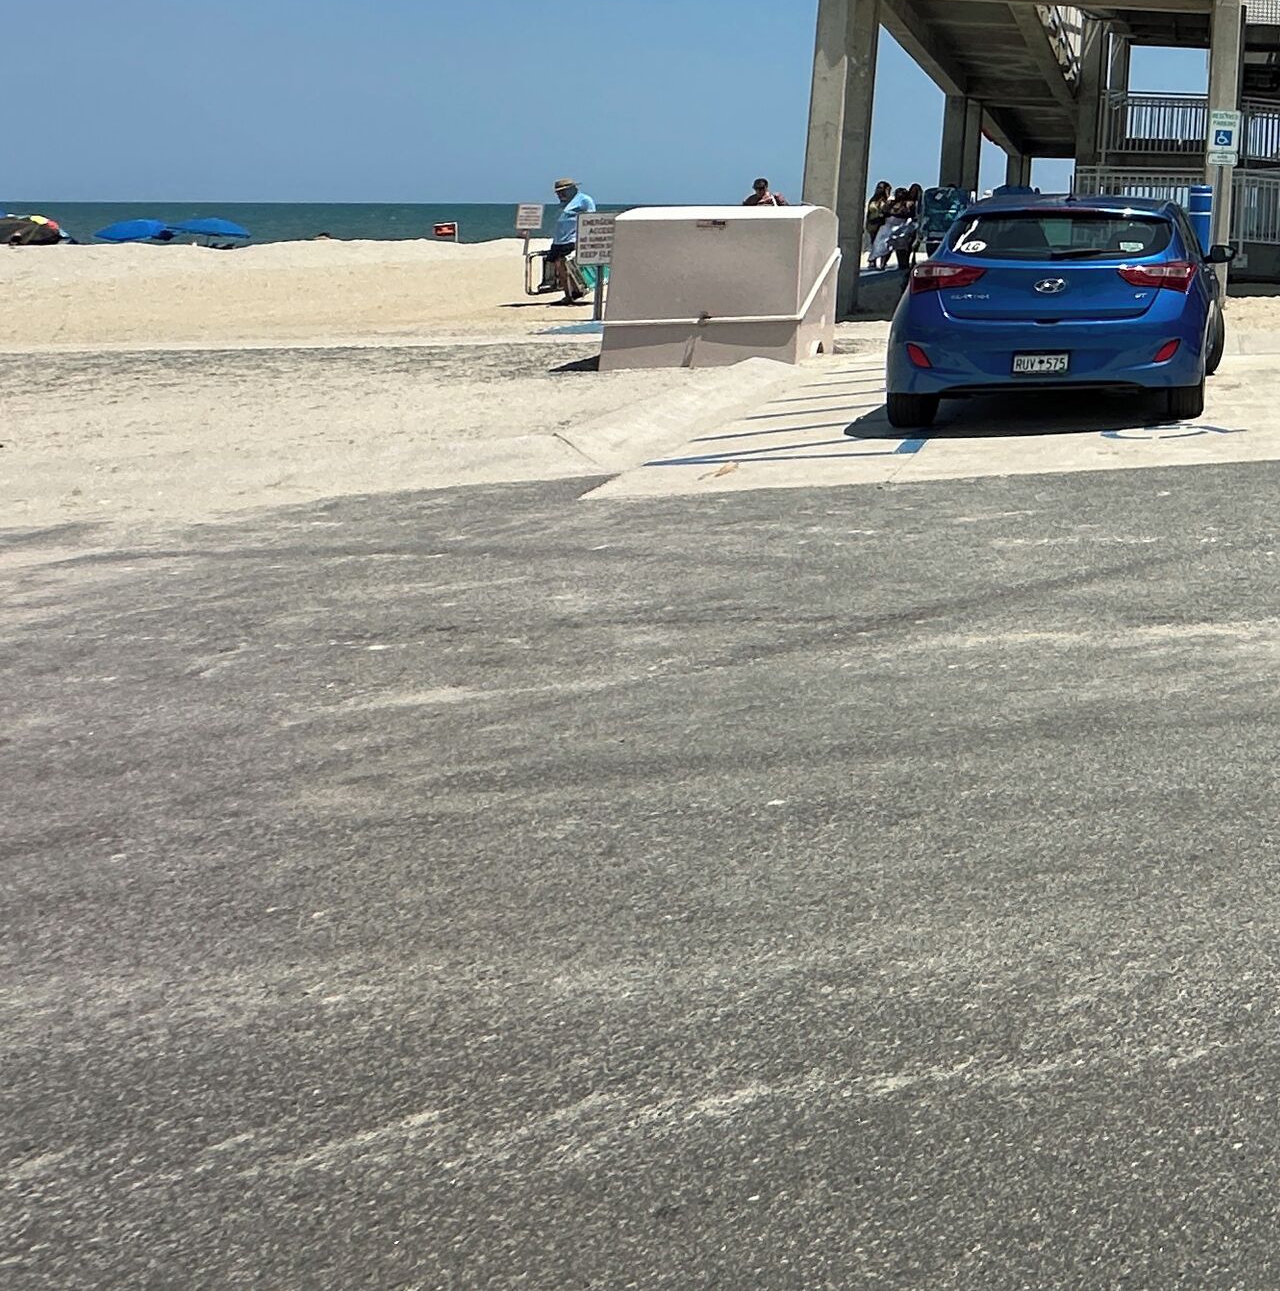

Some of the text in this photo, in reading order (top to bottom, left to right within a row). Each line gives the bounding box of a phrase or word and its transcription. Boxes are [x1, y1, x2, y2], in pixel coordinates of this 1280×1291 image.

[582, 218, 615, 226] EMERGEN
[1015, 357, 1066, 370] RUV 575
